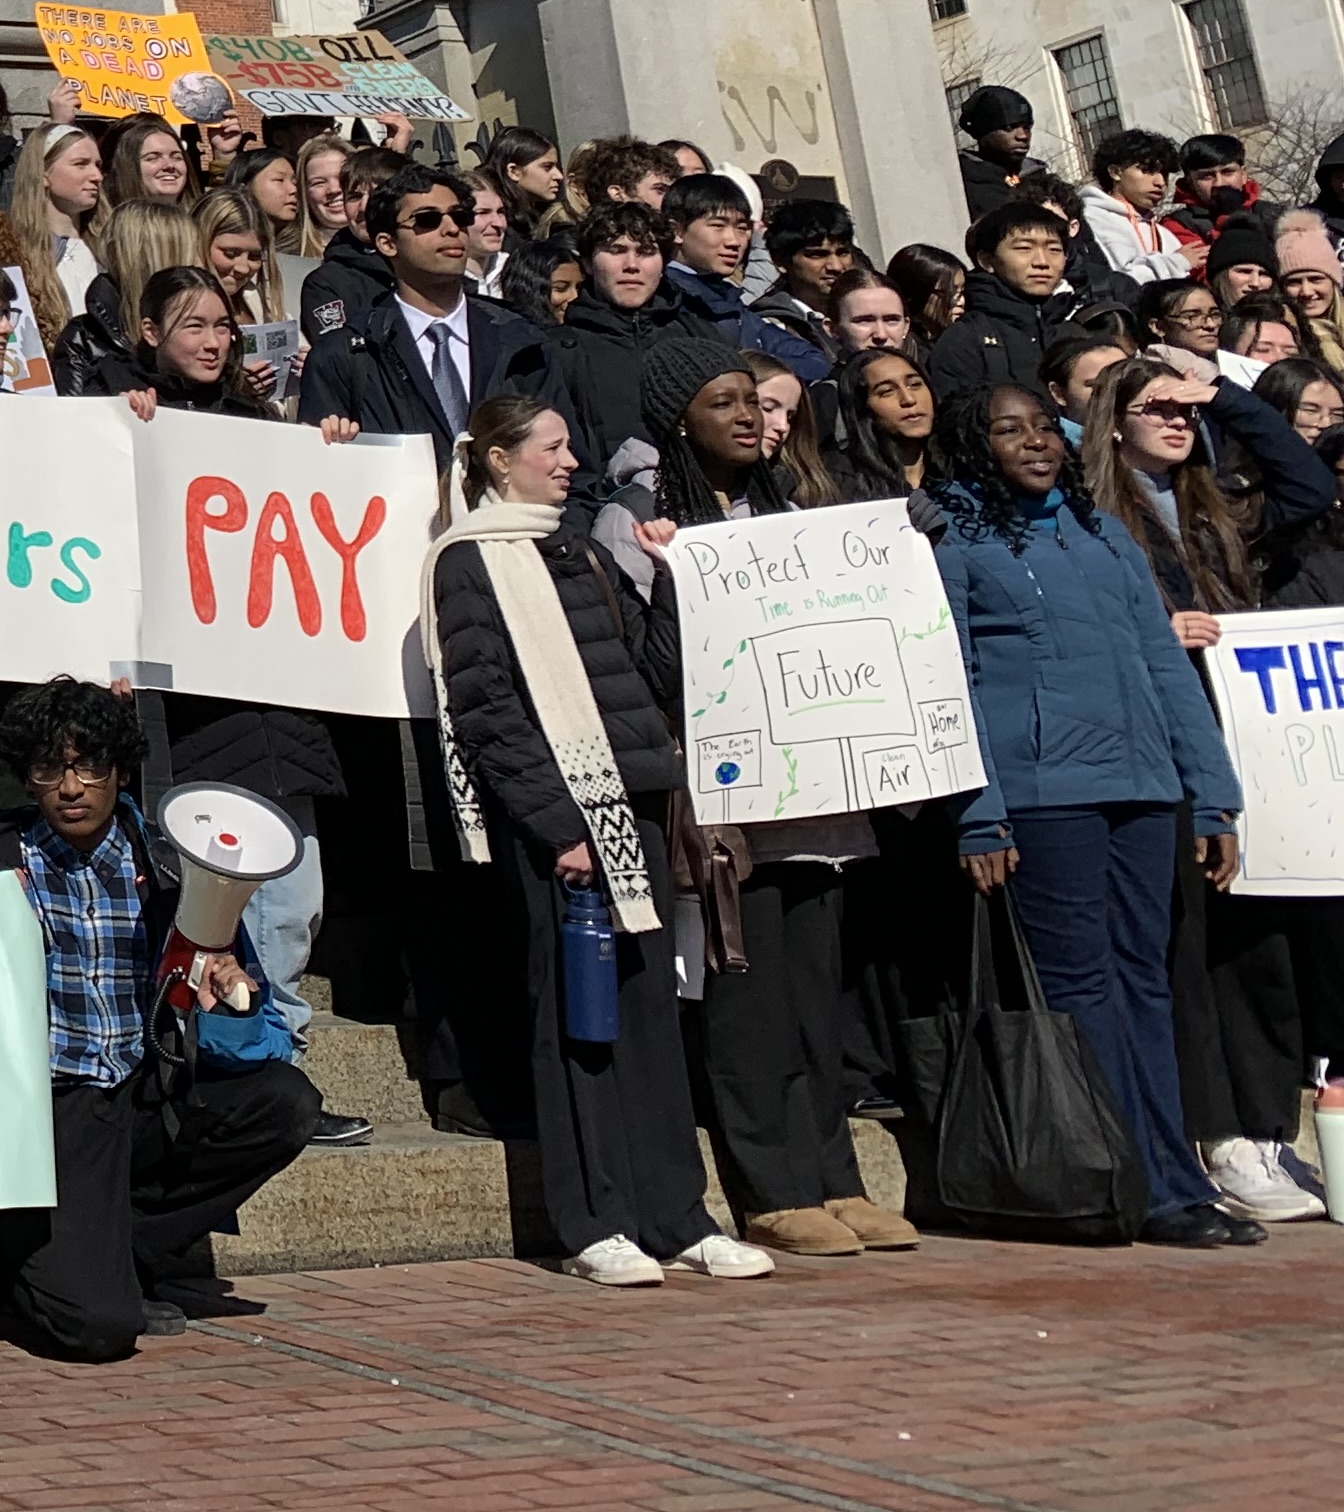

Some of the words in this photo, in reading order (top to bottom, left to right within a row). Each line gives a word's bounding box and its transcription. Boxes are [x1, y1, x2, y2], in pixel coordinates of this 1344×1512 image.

[39, 6, 107, 31] THERE
[118, 15, 160, 34] ARE
[41, 27, 75, 46] NO
[81, 30, 136, 53] JOBS
[145, 37, 192, 59] ON
[318, 36, 395, 63] OIL
[59, 47, 78, 66] A
[80, 48, 164, 81] DEAD
[339, 61, 423, 80] CLEAN
[65, 76, 168, 116] PLANET
[185, 475, 387, 643] PAY
[684, 540, 810, 602] Protect
[842, 530, 891, 569] Our
[754, 595, 794, 623] Time
[816, 588, 866, 612] Running
[866, 584, 889, 604] Out
[776, 649, 882, 708] Future
[927, 712, 961, 736] Home
[701, 741, 720, 752] The
[879, 764, 911, 793] Air
